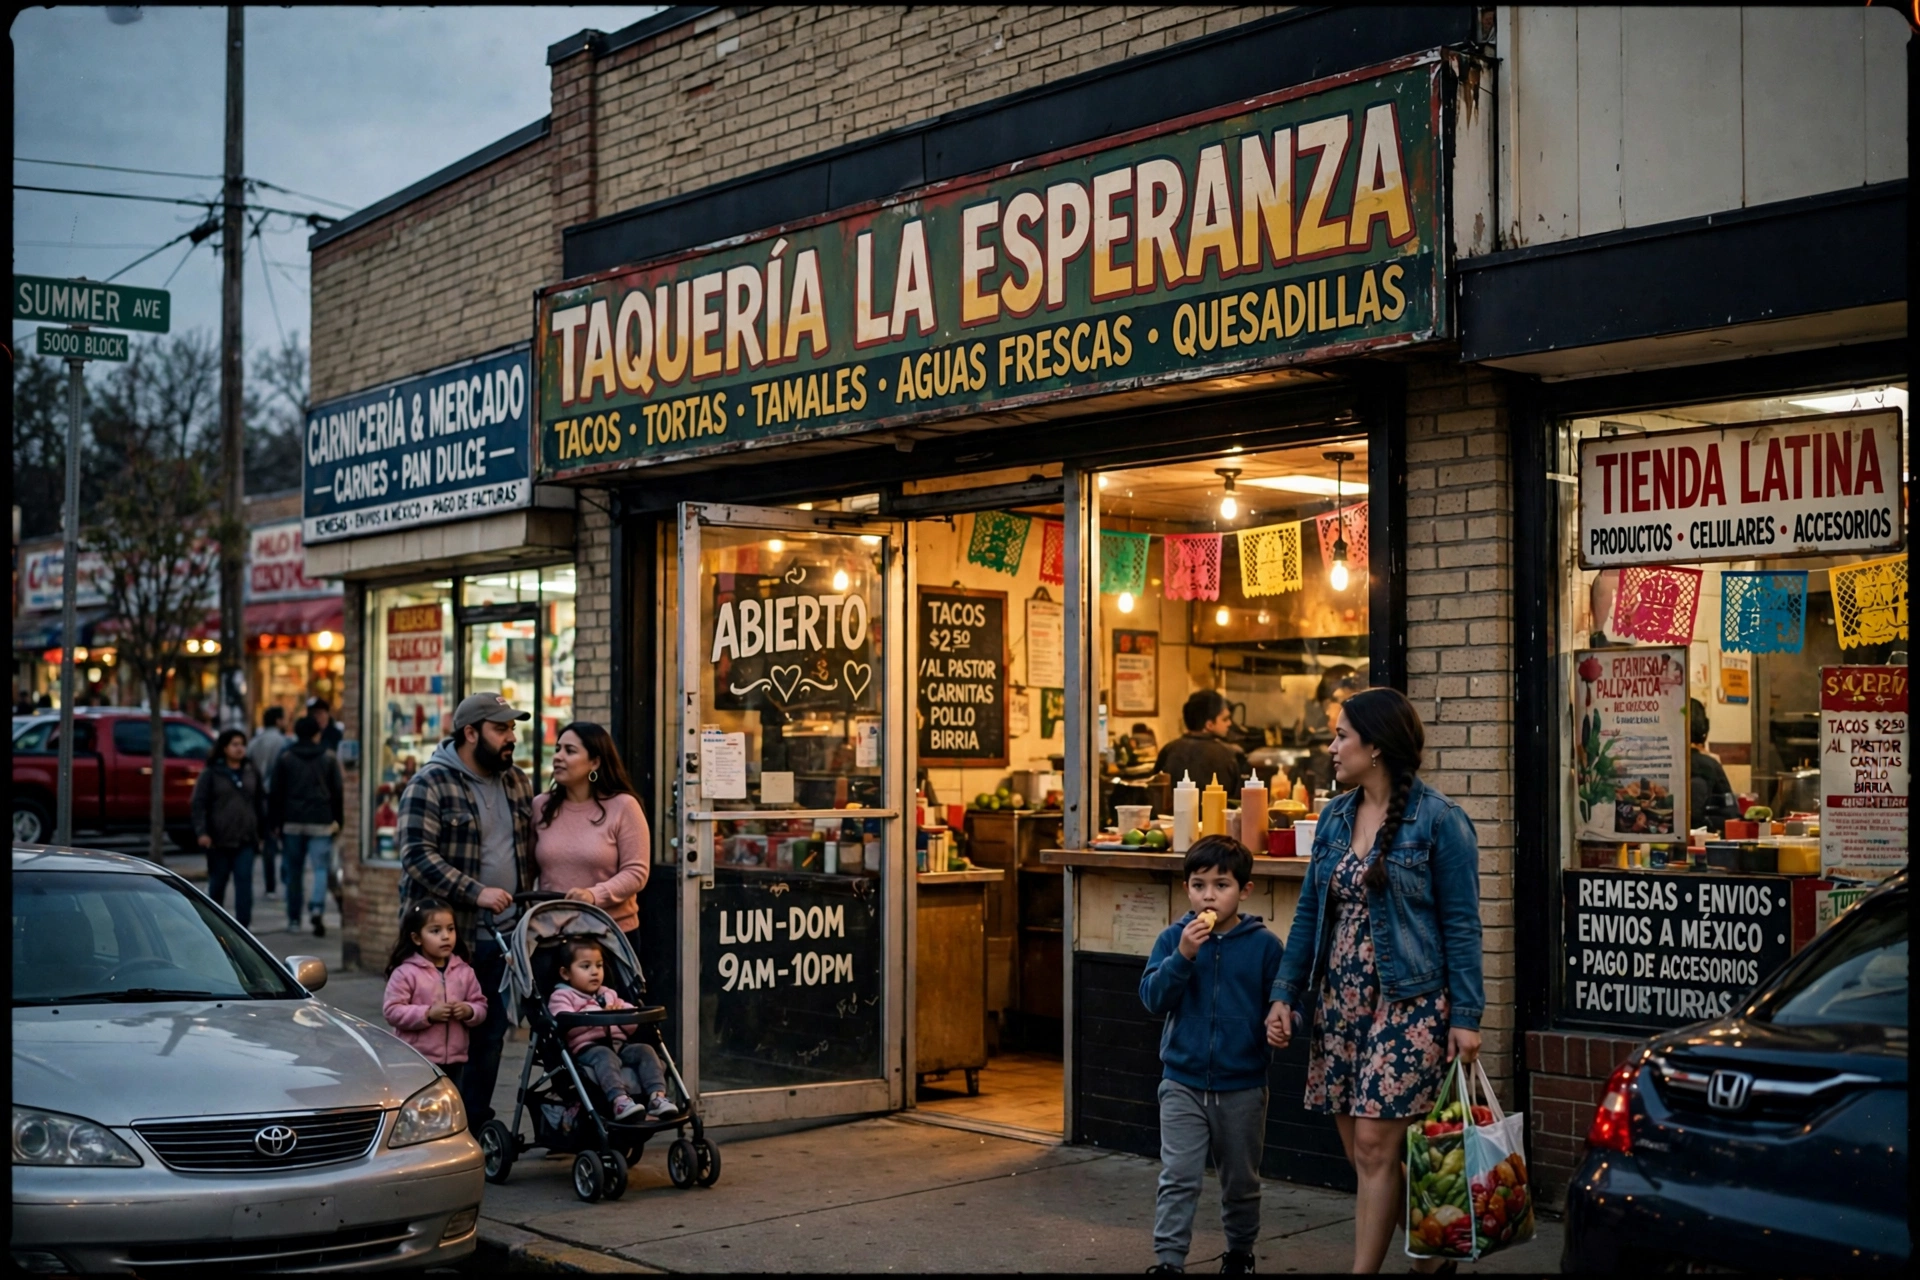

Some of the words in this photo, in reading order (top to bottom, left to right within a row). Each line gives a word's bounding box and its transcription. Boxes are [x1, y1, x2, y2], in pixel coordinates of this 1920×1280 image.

[551, 238, 829, 403] TAQUERÍA
[855, 219, 937, 346] LA
[961, 103, 1413, 324] ESPERANZA
[18, 282, 120, 322] SUMMER
[133, 298, 161, 319] AVE
[43, 332, 79, 353] 5000
[84, 336, 124, 357] BLOCK
[555, 411, 621, 460] TACOS
[643, 392, 728, 446] TORTAS
[752, 365, 868, 427] TAMALES
[896, 343, 987, 403] AGUAS
[999, 315, 1134, 387] FRESCAS
[1172, 264, 1405, 359] QUESADILLAS
[308, 388, 407, 467] CARNICERÍA
[411, 393, 424, 442] &
[429, 364, 524, 438] MERCADO
[334, 459, 389, 503] CARNES
[402, 448, 431, 490] PAN
[436, 436, 486, 484] DULCE
[1596, 443, 1727, 515] TIENDA
[1740, 428, 1884, 504] LATINA
[458, 493, 468, 510] DE
[1590, 523, 1673, 555] PRODUCTOS
[1690, 516, 1775, 549] CELULARES
[1793, 507, 1892, 543] ACCESORIOS
[711, 594, 868, 664] ABIERTO
[928, 601, 985, 627] TACOS
[948, 659, 996, 680] PASTOR
[927, 683, 994, 704] CARNITAS
[930, 707, 975, 726] POLLO
[1828, 719, 1869, 733] TACOS
[930, 730, 979, 750] BIRRIA
[1856, 770, 1888, 780] POLLO
[1579, 878, 1678, 911] REMESAS
[1699, 883, 1772, 916] ENVIOS
[719, 904, 845, 945] LUN-DOM
[1578, 914, 1652, 945] ENVIOS
[1659, 920, 1674, 946] A
[1681, 914, 1763, 953] MÉXICO
[718, 951, 854, 992] 9AM-10PM
[1582, 949, 1628, 976] PAGO
[1633, 952, 1654, 978] DE
[1660, 956, 1758, 985] ACCESORIOS
